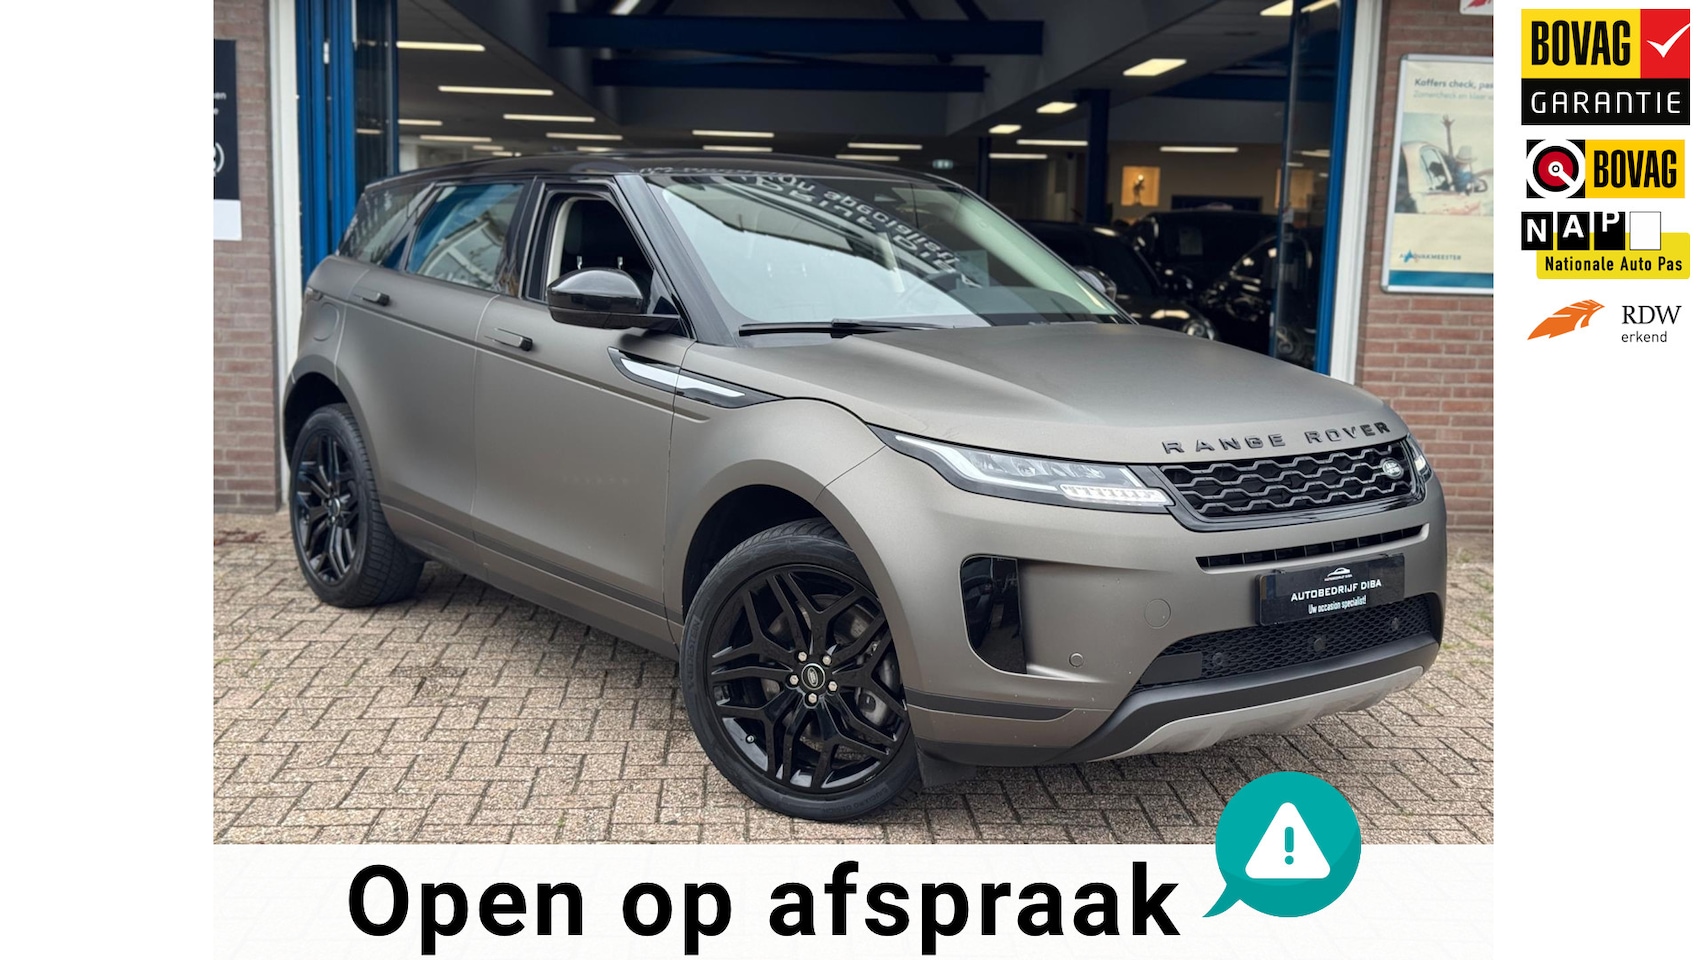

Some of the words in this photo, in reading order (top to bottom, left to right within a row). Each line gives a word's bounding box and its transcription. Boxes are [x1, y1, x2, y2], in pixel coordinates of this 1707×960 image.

[1414, 78, 1447, 88] Koffers
[1448, 79, 1477, 89] check,
[1162, 434, 1286, 454] RANGE
[1304, 421, 1391, 444] ROVER
[1291, 583, 1359, 602] AUTOBEDRIJF
[1360, 579, 1382, 590] DIBA
[1308, 604, 1317, 614] Uw
[1318, 601, 1341, 613] occasion
[1341, 595, 1367, 610] specialist!
